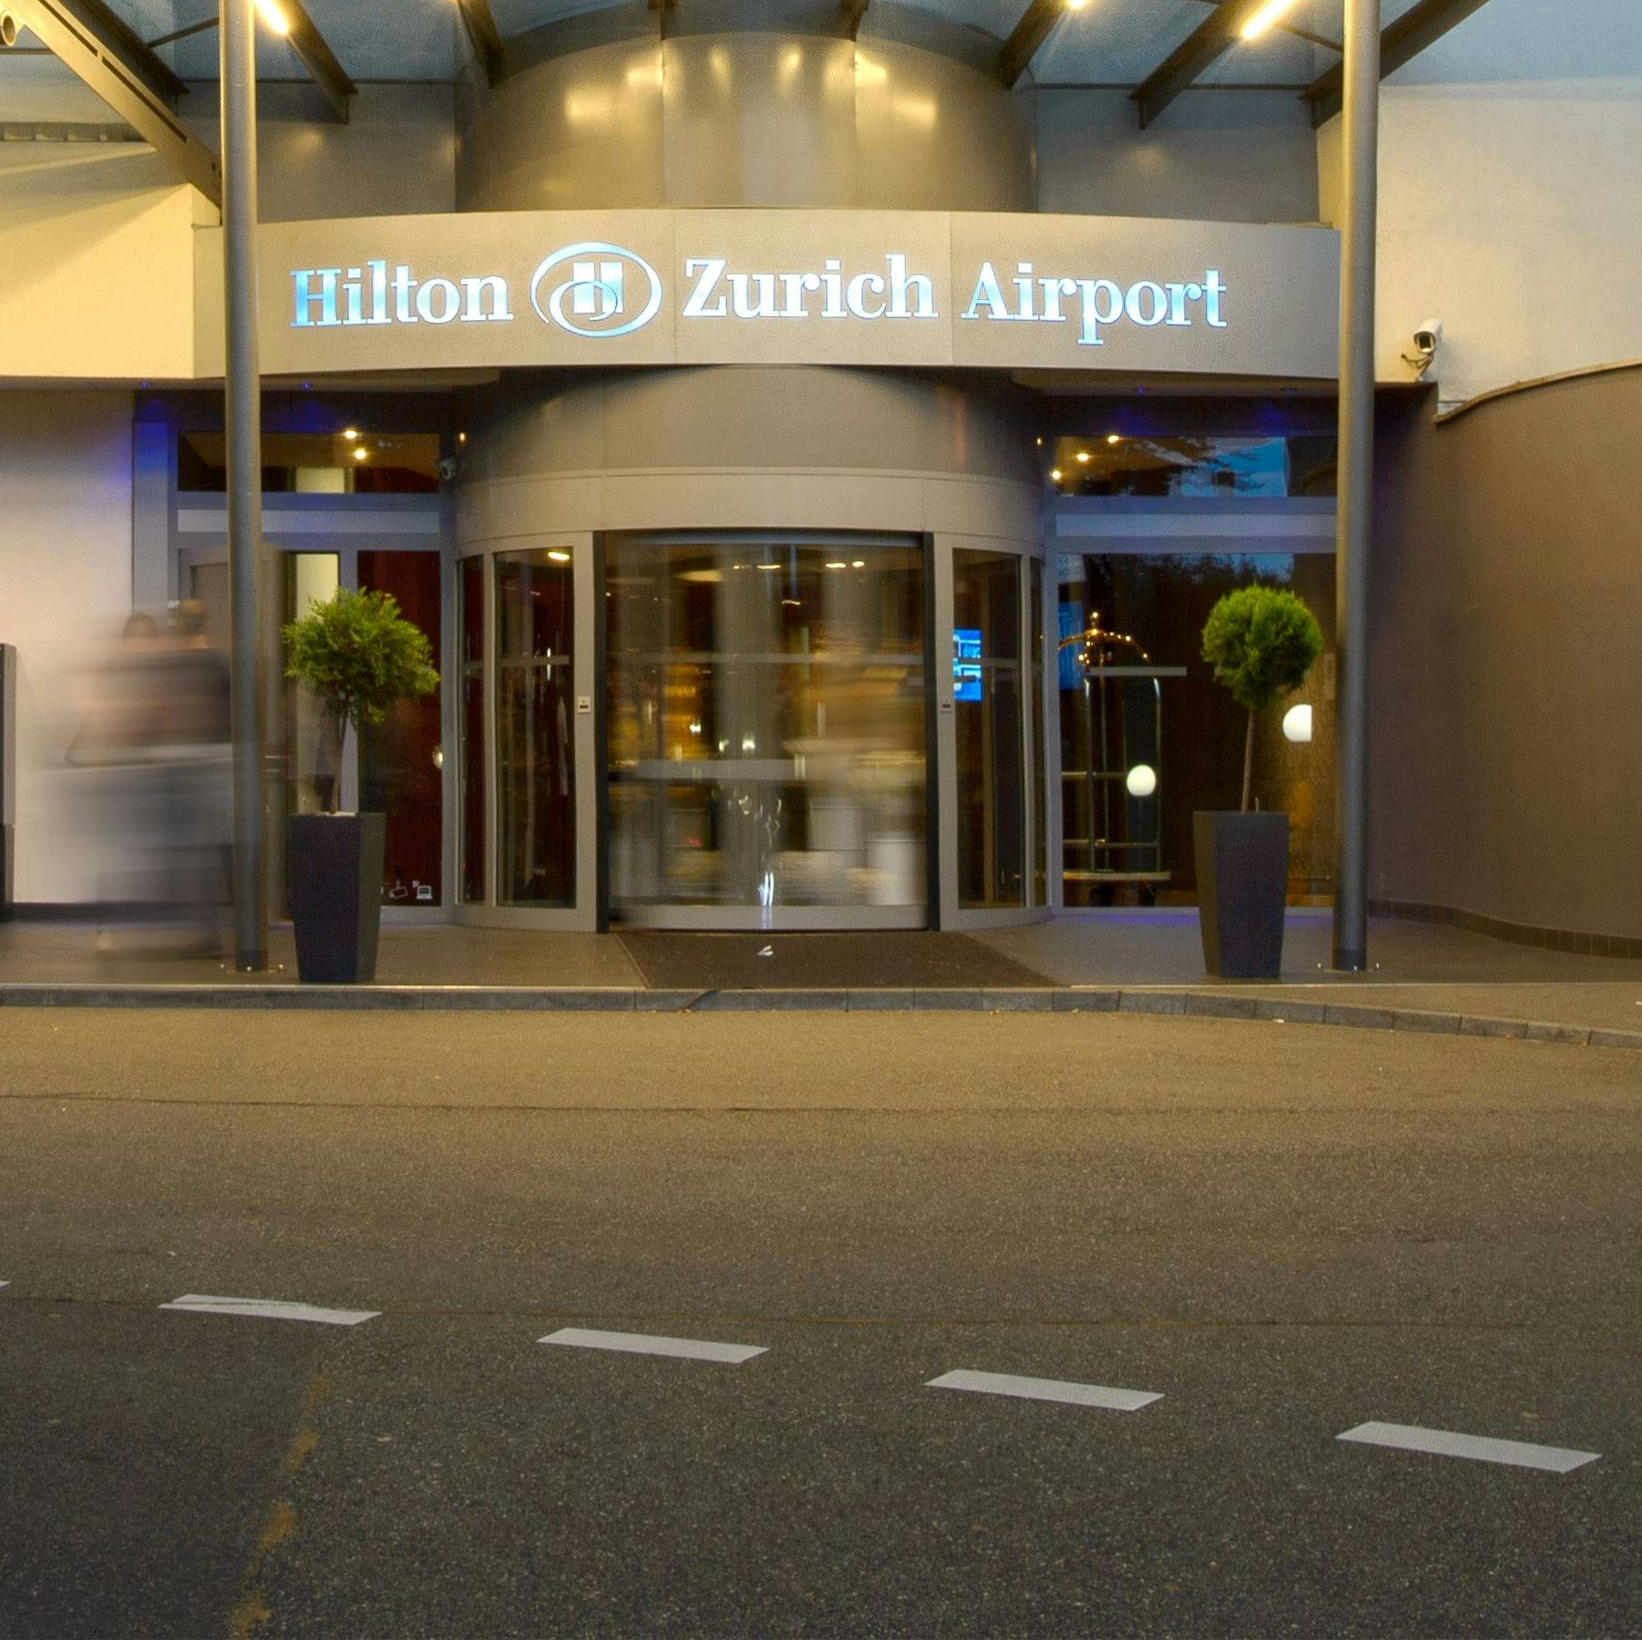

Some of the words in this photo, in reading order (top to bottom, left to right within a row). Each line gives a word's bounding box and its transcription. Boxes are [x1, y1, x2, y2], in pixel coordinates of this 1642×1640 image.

[291, 259, 514, 330] Hilton
[682, 254, 938, 320] Zurich
[962, 261, 1228, 347] Airport
